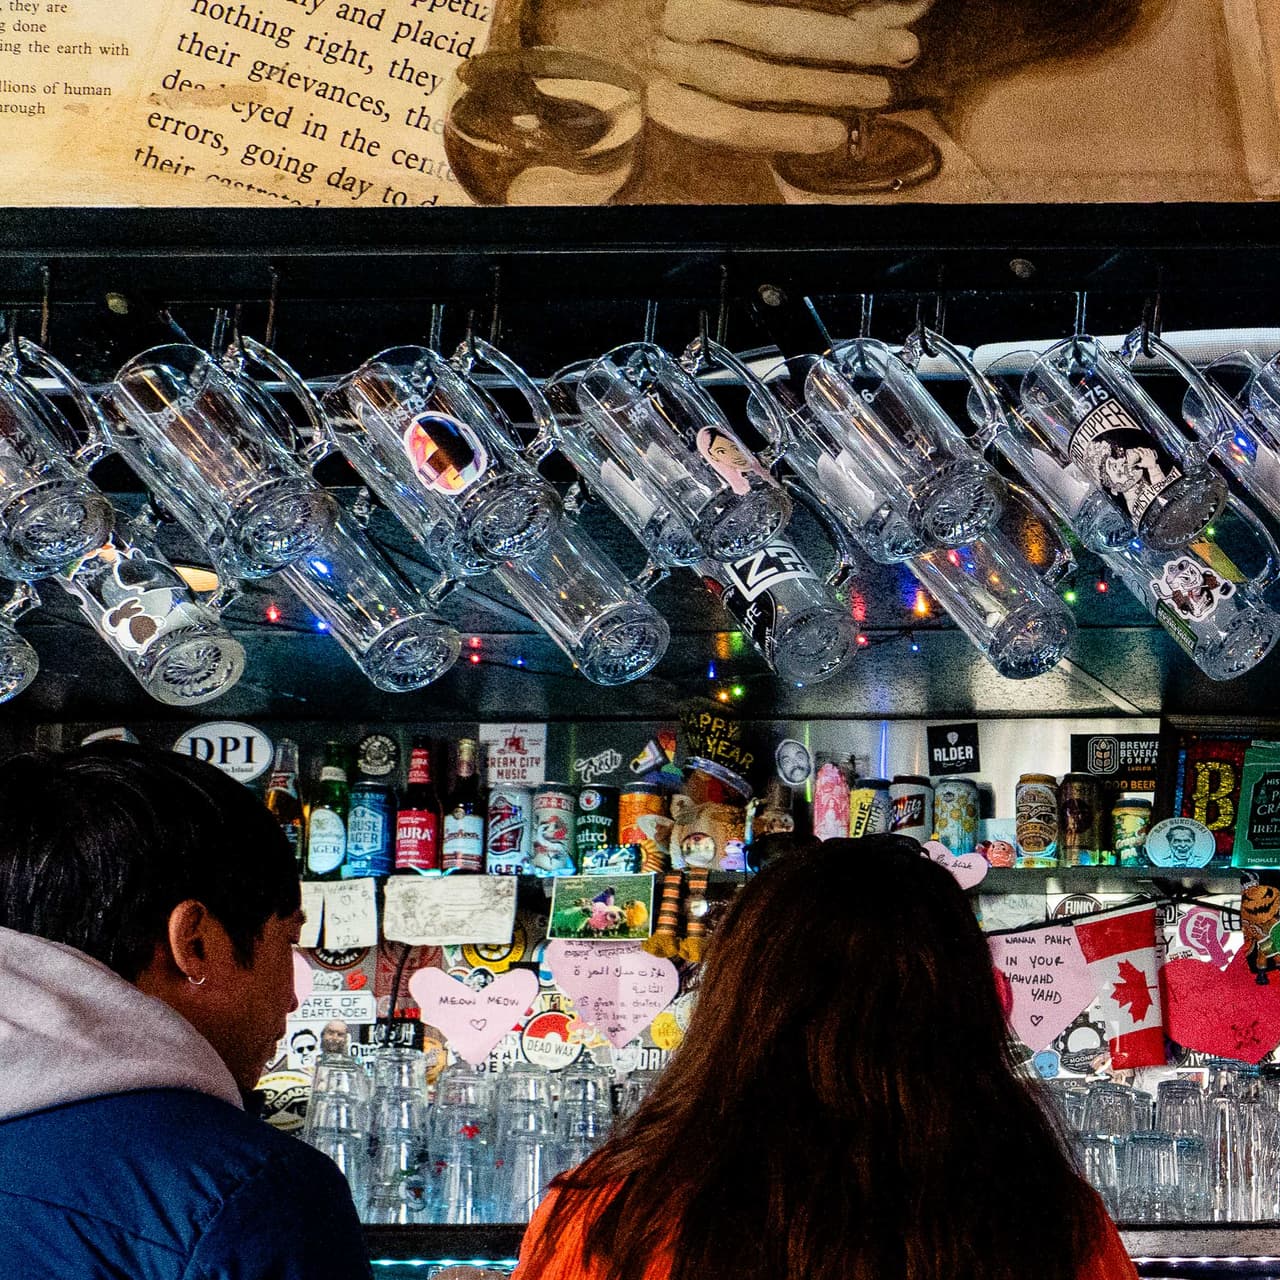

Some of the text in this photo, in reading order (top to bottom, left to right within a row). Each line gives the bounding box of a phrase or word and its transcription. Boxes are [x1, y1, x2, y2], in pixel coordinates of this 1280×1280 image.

[9, 1, 68, 14] they are
[13, 20, 47, 33] done
[336, 2, 475, 59] and placid
[28, 43, 130, 56] the earth with
[190, 0, 445, 96] nothing right, they
[177, 31, 241, 67] their
[247, 59, 390, 123] grievances,
[43, 82, 112, 96] of human
[302, 113, 381, 157] in the
[147, 112, 229, 156] errors,
[240, 141, 318, 184] going
[326, 166, 374, 201] day
[382, 186, 408, 205] to
[1079, 400, 1137, 441] TOPPER
[189, 736, 256, 765] DPI
[933, 744, 974, 762] ALDER
[520, 757, 540, 767] CITY
[497, 769, 527, 779] MUSIC
[1131, 780, 1156, 789] BEER
[1192, 761, 1236, 830] B
[586, 816, 613, 825] STOUT
[853, 802, 870, 837] TRUE
[1064, 901, 1095, 915] FUNKY
[1005, 956, 1065, 967] IN YOUR
[341, 997, 361, 1007] OF
[1031, 988, 1063, 1004] YAHD
[302, 1007, 367, 1018] BARTENDER
[527, 1039, 575, 1057] DEAD WAX
